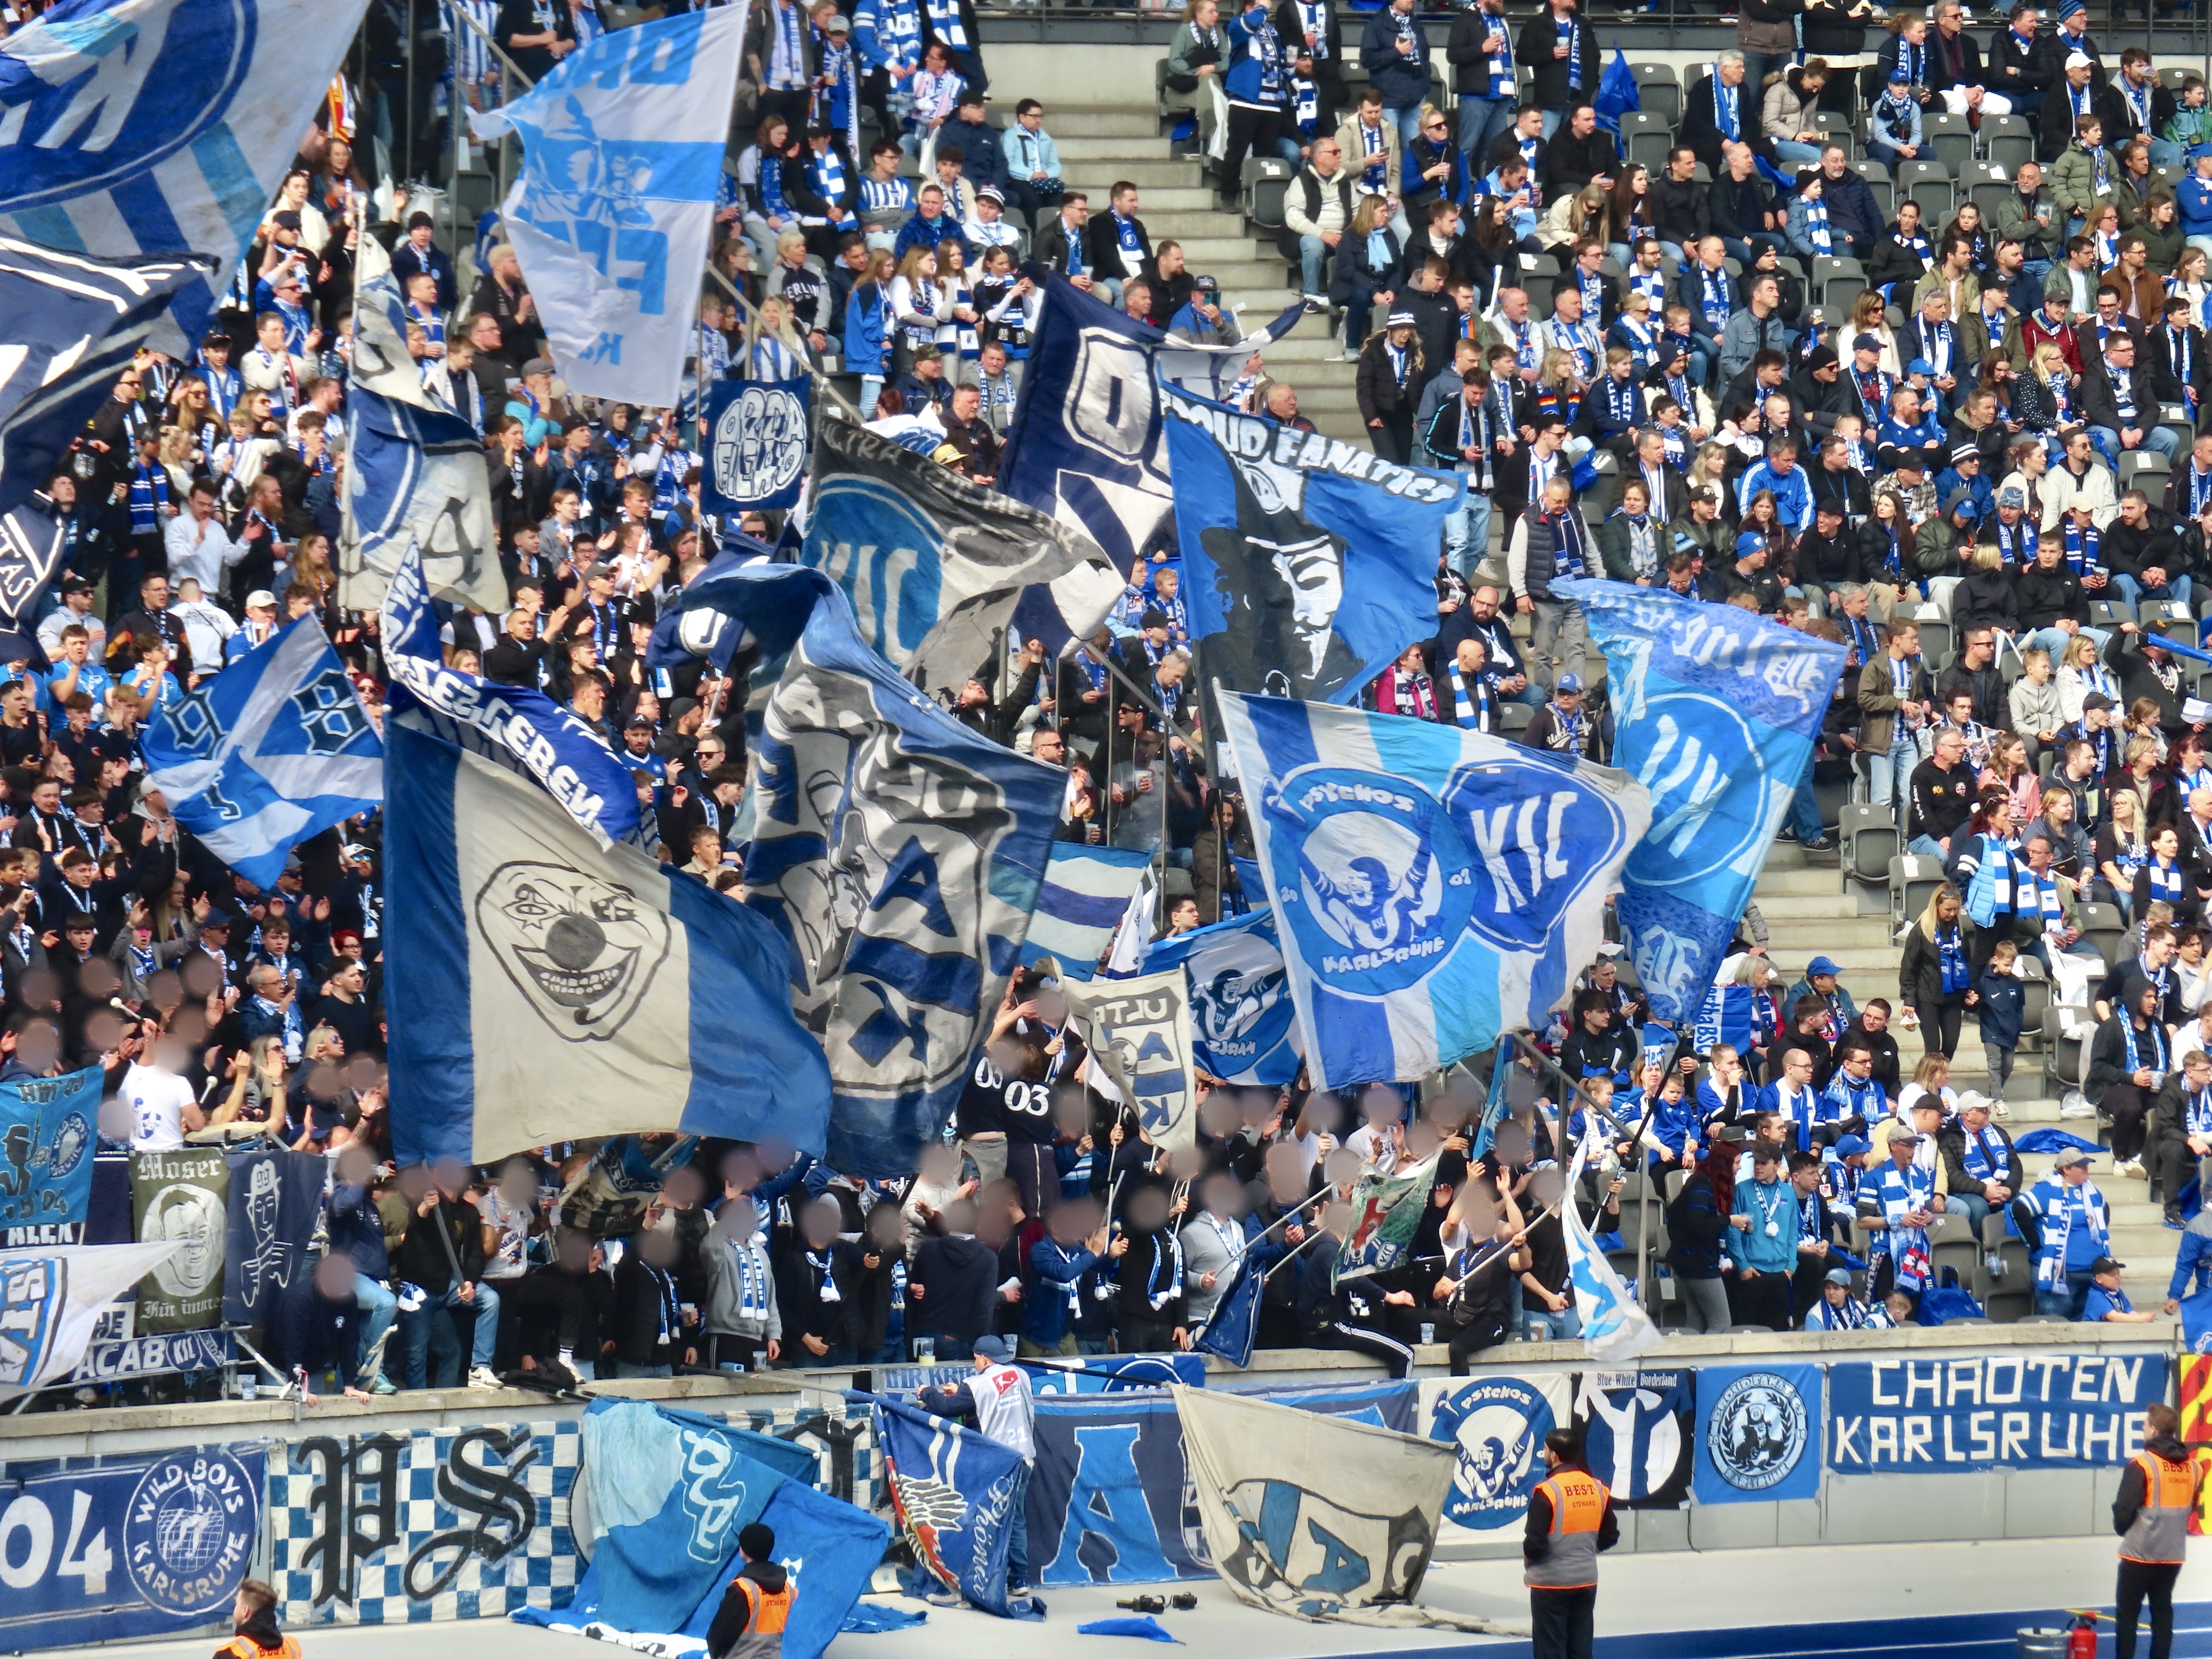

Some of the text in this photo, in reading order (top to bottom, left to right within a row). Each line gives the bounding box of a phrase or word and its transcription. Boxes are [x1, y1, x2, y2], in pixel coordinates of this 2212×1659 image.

[1299, 782, 1415, 813] PSYCHOS
[1469, 791, 1578, 914] KSC
[1323, 938, 1445, 974] KARLSRUHE
[1004, 1081, 1050, 1116] 03
[137, 1154, 221, 1181] Moser
[71, 1338, 166, 1382] ACAB
[1460, 1385, 1533, 1409] PSYCHOS
[1598, 1373, 1677, 1387] Blue-White Borderland
[1872, 1355, 2143, 1408] CHAOTEN
[1007, 1426, 1027, 1445] 21
[1836, 1411, 2148, 1464] KARLSRUHE
[134, 1458, 245, 1524] WILD BOYS
[1452, 1493, 1529, 1515] KARLSRUHE
[1572, 1500, 1596, 1509] STEWARD
[132, 1531, 247, 1605] KARLSRUHE
